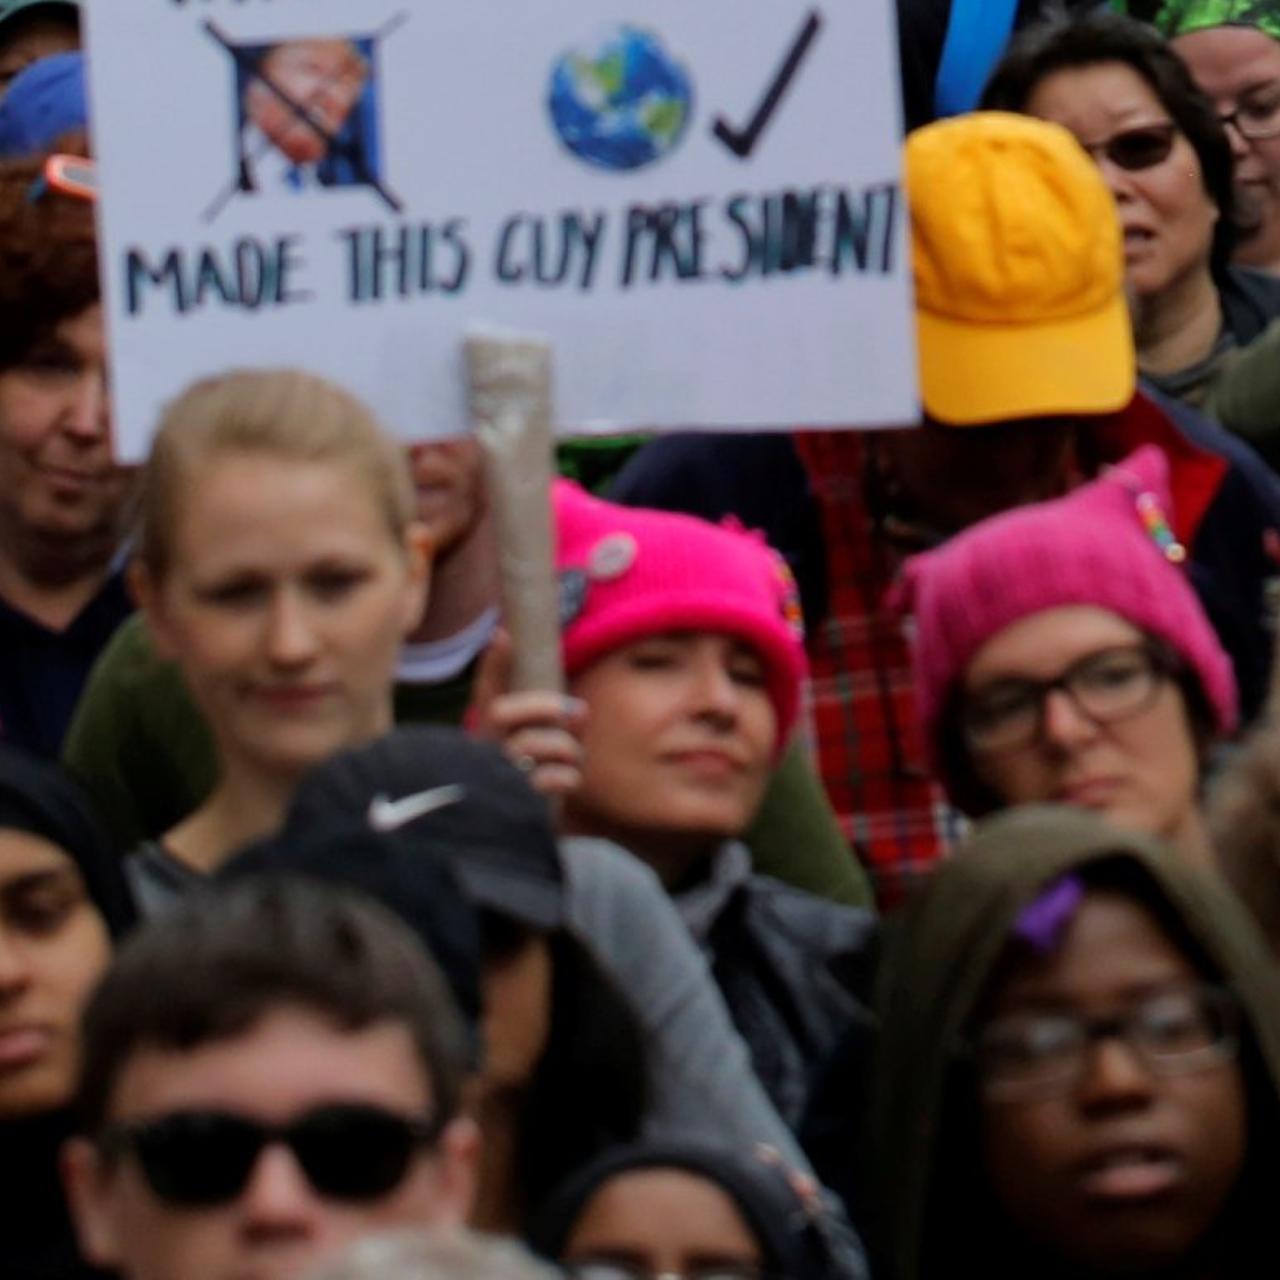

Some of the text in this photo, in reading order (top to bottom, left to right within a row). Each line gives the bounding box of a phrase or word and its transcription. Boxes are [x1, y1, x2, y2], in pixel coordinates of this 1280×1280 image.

[125, 231, 318, 319] MADE
[339, 217, 473, 303] THIS
[623, 181, 904, 288] PRESIDENT
